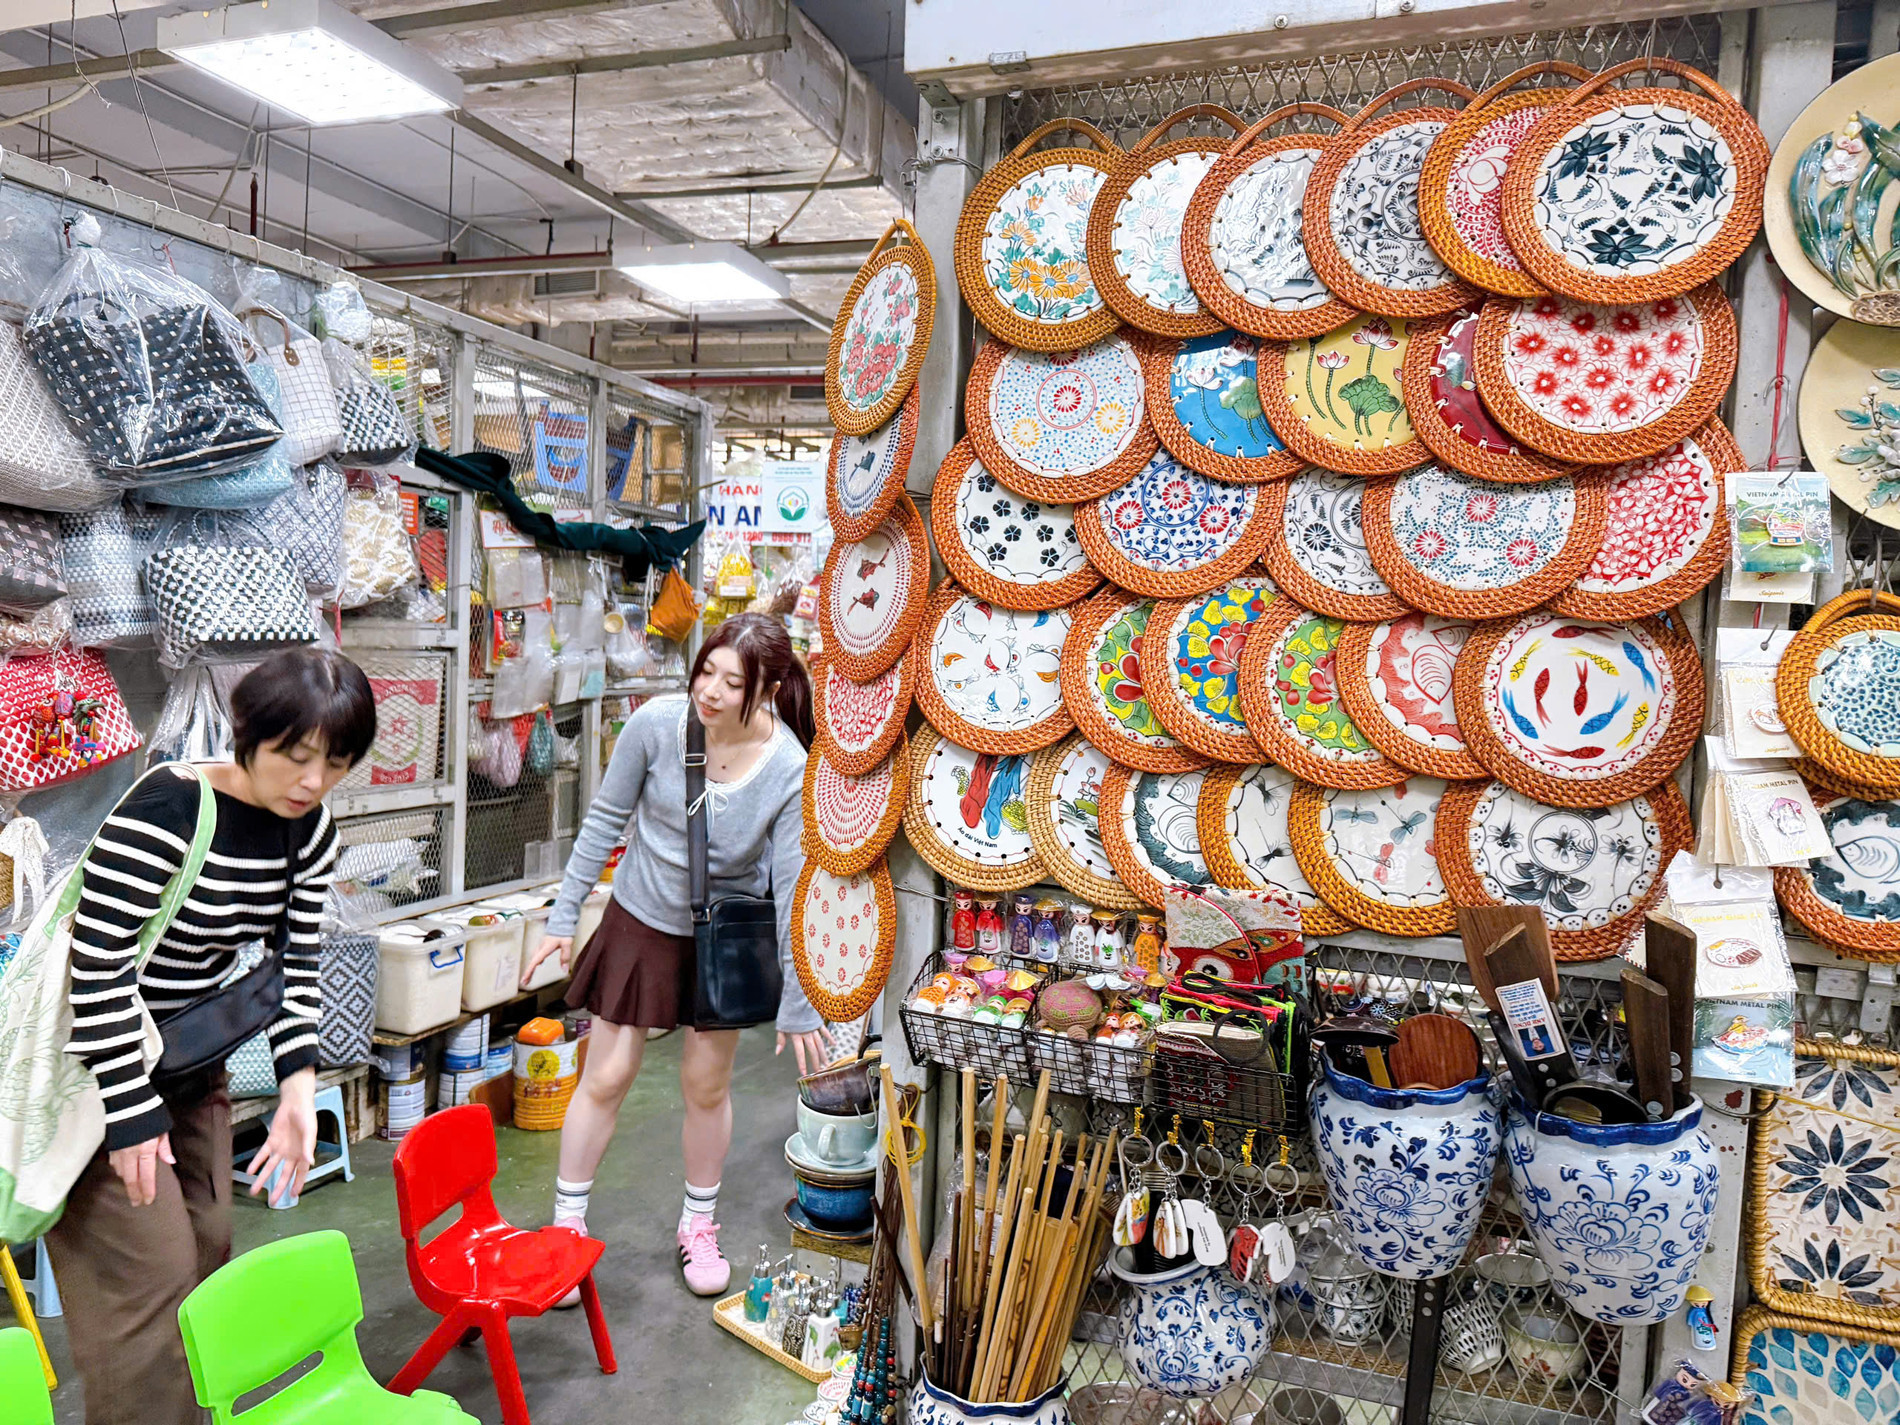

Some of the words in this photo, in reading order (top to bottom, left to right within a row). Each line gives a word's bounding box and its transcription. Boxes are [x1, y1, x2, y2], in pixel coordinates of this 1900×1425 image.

[719, 481, 763, 496] HÀN
[1788, 778, 1799, 786] PIN
[1740, 1000, 1765, 1009] METAL
[1766, 1002, 1781, 1010] PIN
